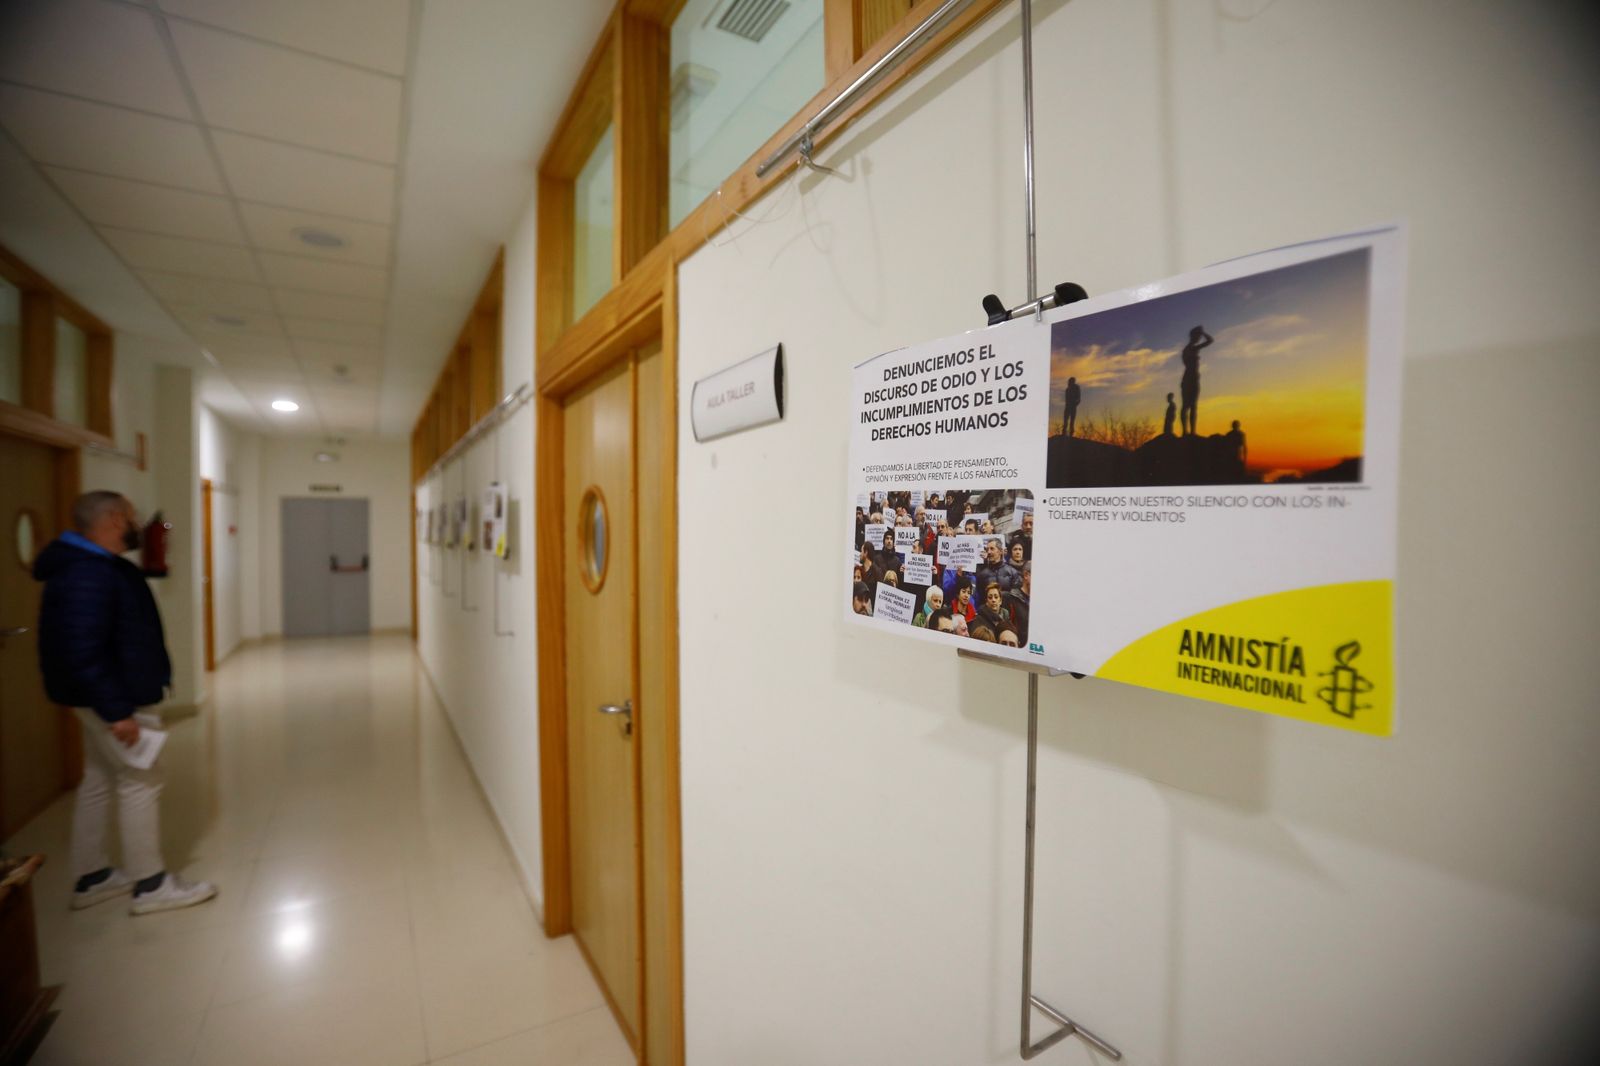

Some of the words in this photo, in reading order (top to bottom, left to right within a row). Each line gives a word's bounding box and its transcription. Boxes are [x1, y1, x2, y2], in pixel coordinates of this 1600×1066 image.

[884, 348, 974, 381] DENUNCIEMOS
[979, 344, 996, 360] EL
[707, 393, 725, 409] AULA
[726, 381, 755, 402] TALLER
[864, 382, 918, 404] DISCURSO
[921, 378, 937, 394] DE
[941, 370, 976, 390] ODIO
[980, 367, 990, 383] Y
[994, 361, 1024, 381] LOS
[861, 393, 969, 424] INCUMPLIMIENTOS
[974, 390, 993, 407] DE
[998, 384, 1027, 404] LOS
[871, 421, 931, 441] DERECHOS
[935, 411, 1008, 434] HUMANOS
[866, 463, 904, 473] DEFENDAMOS
[905, 463, 912, 471] LA
[914, 460, 942, 471] LIBERTAD
[943, 460, 953, 469] DE
[954, 457, 1008, 468] PENSAMIENTO,
[866, 472, 889, 483] OPINIÓN
[890, 473, 894, 482] Y
[895, 472, 926, 482] EXPRESIÓN
[928, 472, 951, 481] FRENTE
[953, 471, 959, 480] A
[960, 470, 974, 479] LOS
[976, 468, 1018, 478] FANÁTICOS
[1049, 496, 1126, 507] CUESTIONEMOS
[1130, 496, 1184, 507] NUESTRO
[1187, 496, 1248, 508] SILENCIO
[1253, 496, 1287, 508] CON
[1292, 496, 1323, 508] LOS
[1049, 510, 1109, 521] TOLERANTES
[1112, 511, 1118, 520] Y
[1121, 511, 1186, 523] VIOLENTOS
[898, 531, 904, 539] NO
[941, 542, 949, 550] NO
[1178, 629, 1306, 677] AMNISTÍA
[1177, 661, 1307, 704] INTERNACIONAL
